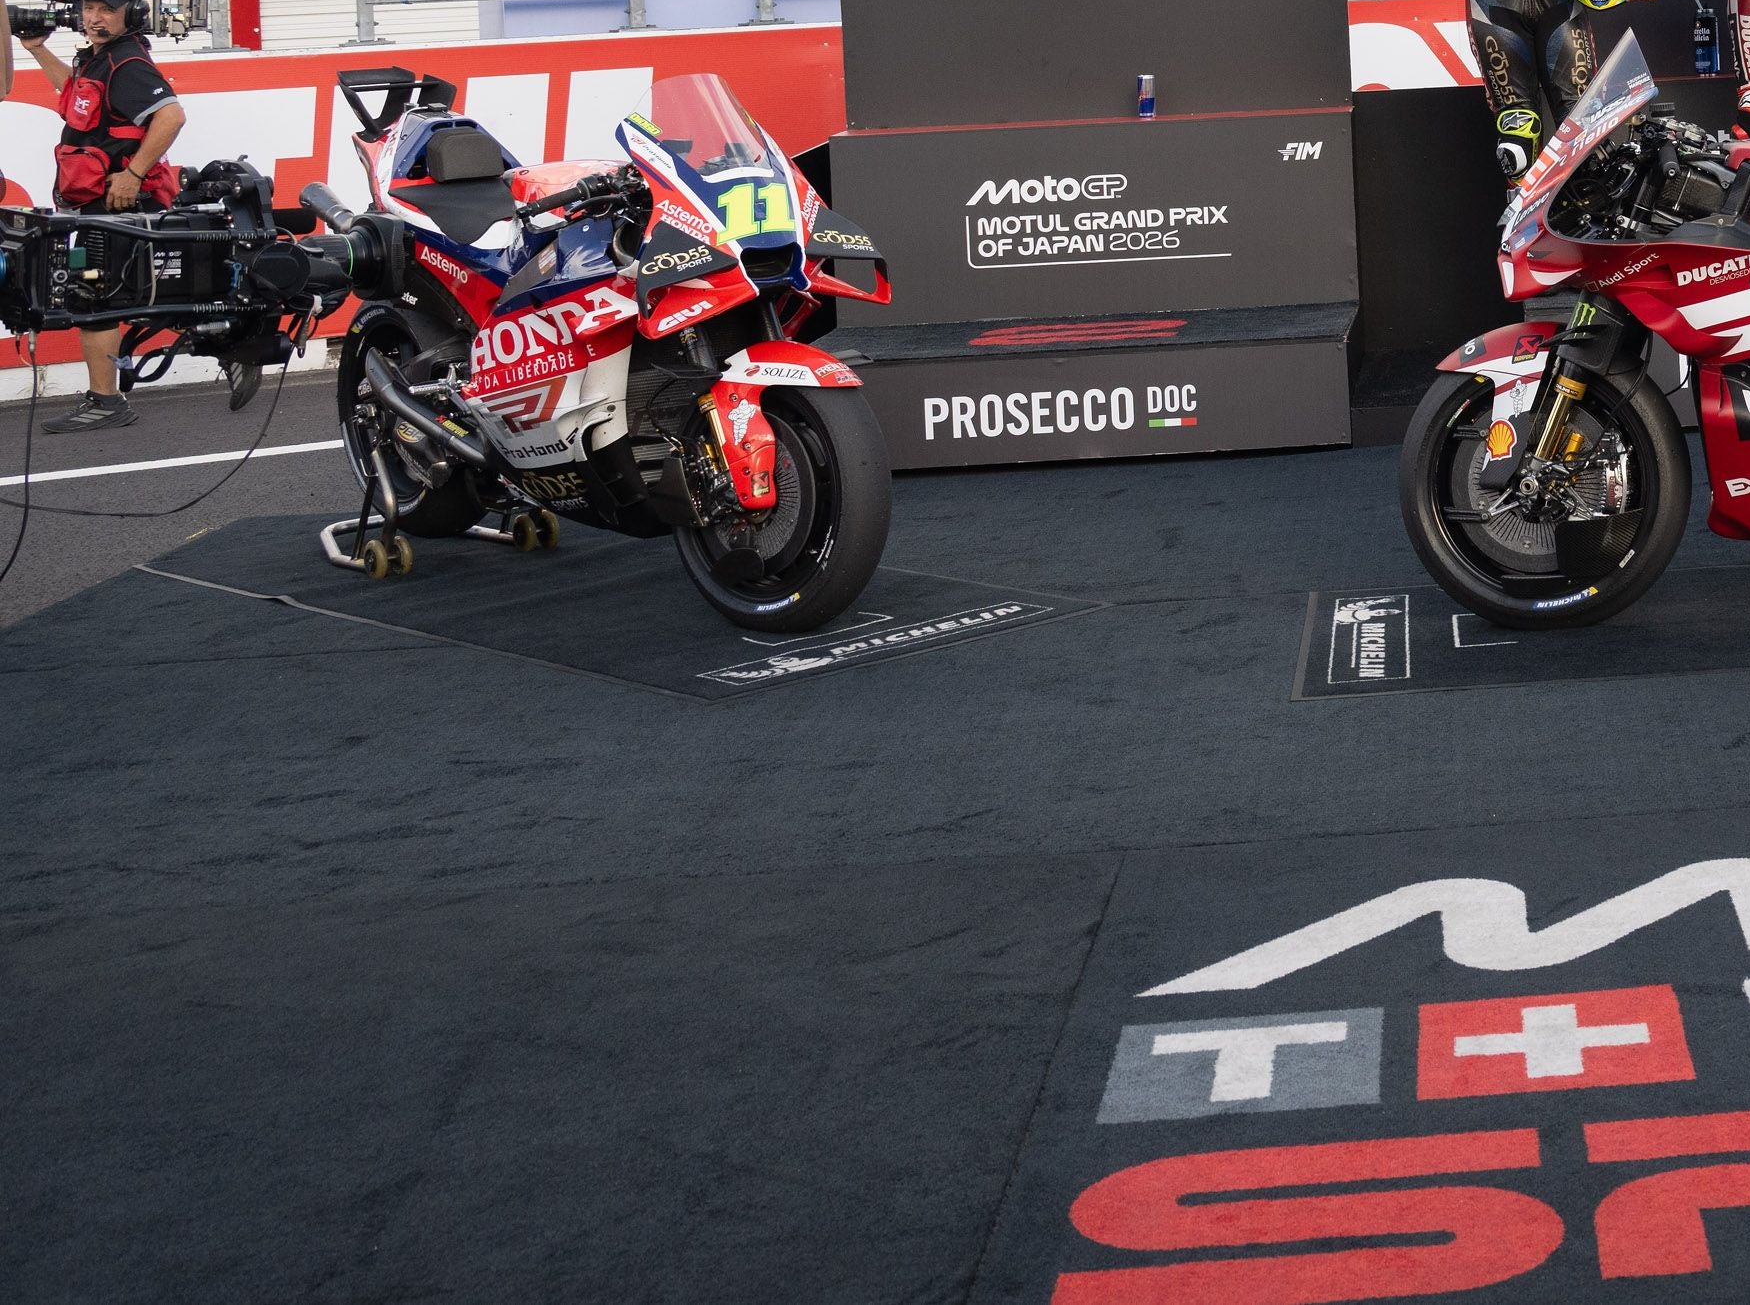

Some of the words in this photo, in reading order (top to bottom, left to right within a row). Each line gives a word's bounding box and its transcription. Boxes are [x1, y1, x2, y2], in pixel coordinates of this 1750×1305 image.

[1277, 141, 1323, 161] FIM
[799, 186, 817, 222] Astemo
[965, 173, 1128, 206] MotoGP
[655, 198, 714, 234] Astemo
[659, 213, 711, 244] HONDA
[716, 182, 796, 246] 11
[806, 200, 822, 234] HONDA
[977, 212, 1070, 237] MOTUL
[1078, 208, 1165, 231] GRAND
[1169, 205, 1229, 227] PRIX
[842, 244, 875, 252] SPORTS
[977, 237, 1014, 258] OF
[1017, 233, 1105, 256] JAPAN
[1109, 229, 1181, 252] 2026
[420, 246, 468, 284] Astemo
[676, 254, 714, 273] SPORTS
[1598, 271, 1626, 288] Audi
[1623, 252, 1660, 276] Sport
[471, 286, 640, 375] HONDA
[657, 300, 714, 332] GIVI
[761, 366, 807, 380] SOLIZE
[923, 386, 1135, 441] PROSECCO
[1146, 384, 1197, 414] DOC
[829, 604, 1024, 655] MICHELIN
[1359, 623, 1386, 678] MICHELIN
